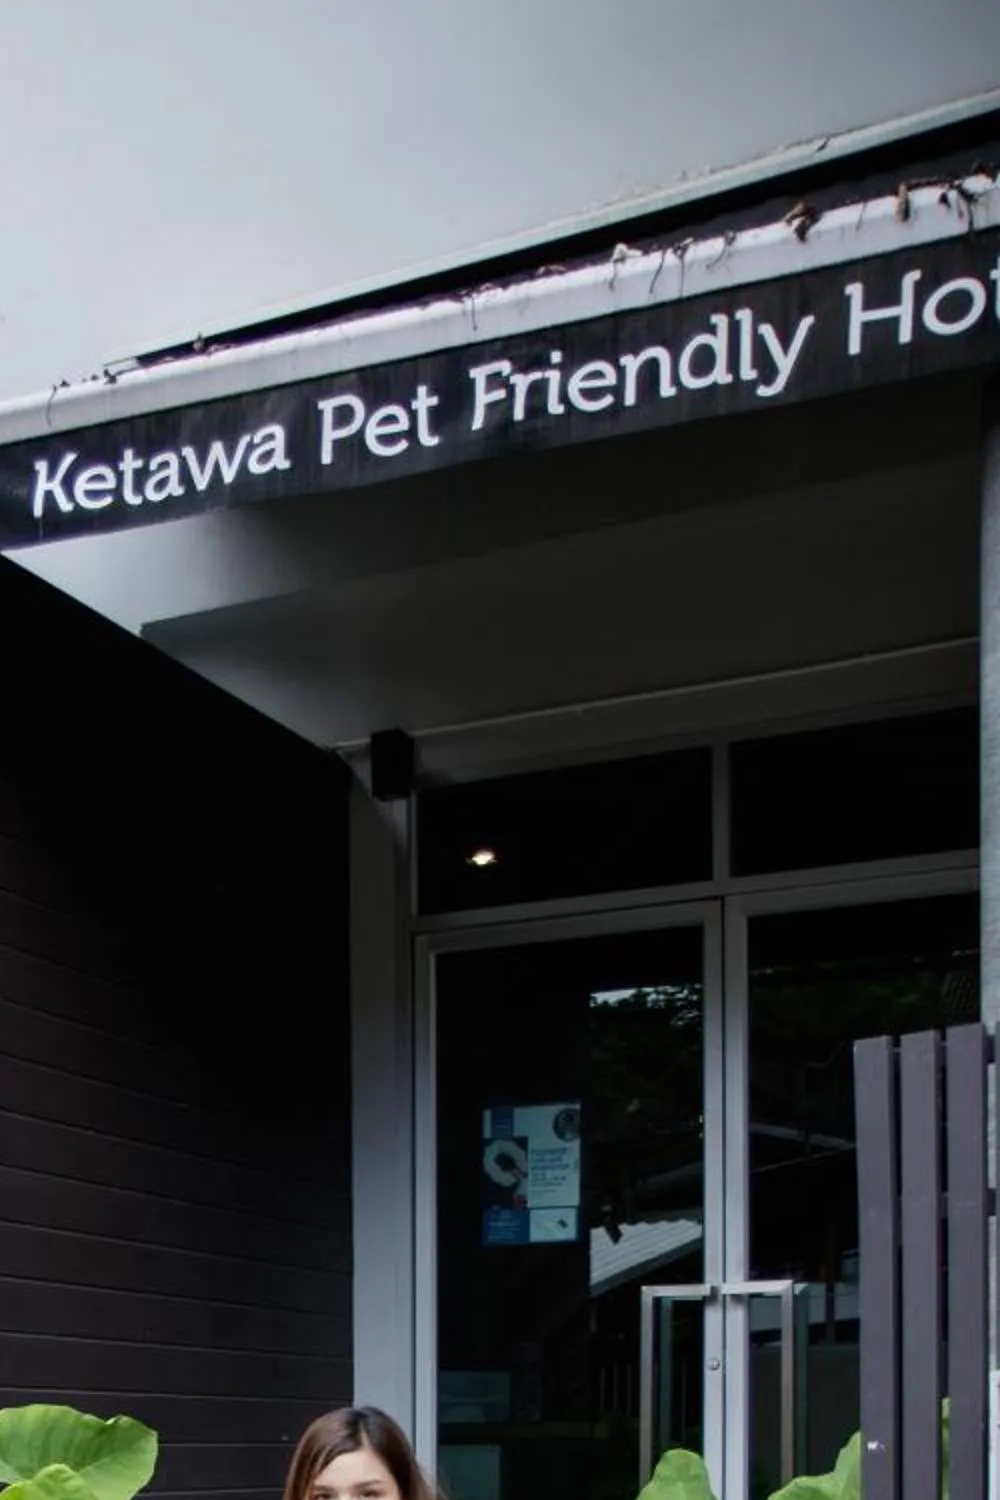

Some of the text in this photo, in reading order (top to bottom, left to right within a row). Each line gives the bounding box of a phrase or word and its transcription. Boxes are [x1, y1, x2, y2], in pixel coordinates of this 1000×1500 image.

[32, 422, 291, 519] Ketawa
[317, 384, 440, 466] Pet
[468, 307, 815, 432] Friendly
